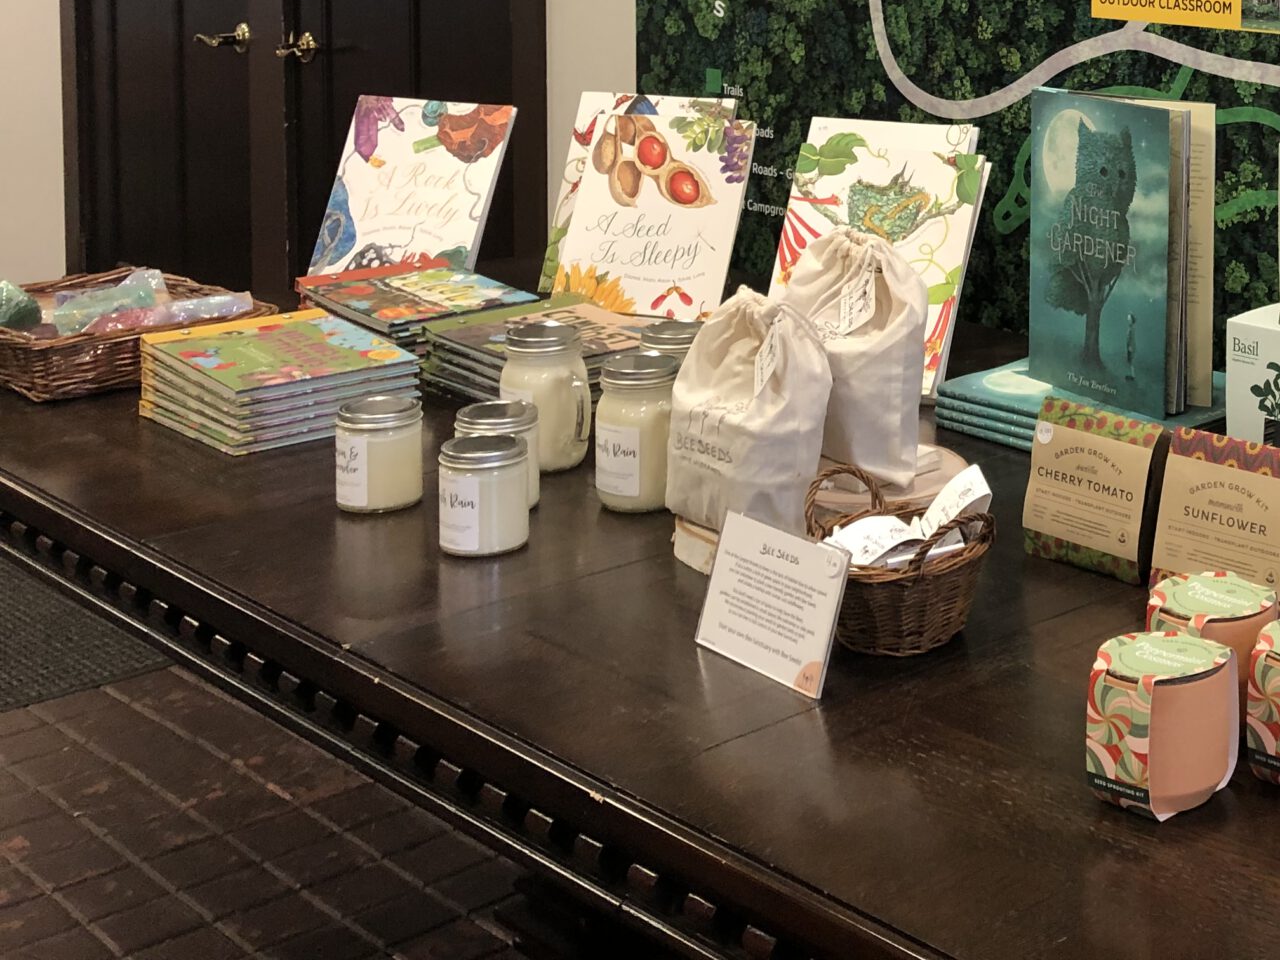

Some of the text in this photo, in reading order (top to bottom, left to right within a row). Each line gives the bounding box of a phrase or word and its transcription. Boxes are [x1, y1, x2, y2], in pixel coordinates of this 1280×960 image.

[712, 0, 725, 18] S
[723, 83, 744, 97] Trails
[752, 162, 778, 176] Roads
[746, 199, 787, 217] Campgro
[611, 213, 672, 239] Seed
[620, 240, 699, 270] Sleepy
[1232, 337, 1259, 356] Basil
[612, 443, 637, 459] Rain
[1054, 446, 1085, 459] GARDEN
[1087, 448, 1111, 463] GROW
[1111, 462, 1123, 476] KIT
[1037, 466, 1083, 487] CHERRY
[1087, 479, 1133, 502] TOMATO
[449, 492, 476, 510] Rain
[1189, 481, 1225, 495] GARDEN
[1228, 483, 1256, 499] GROW
[1255, 497, 1269, 512] KIT
[1183, 505, 1267, 536] SUNFLOWER
